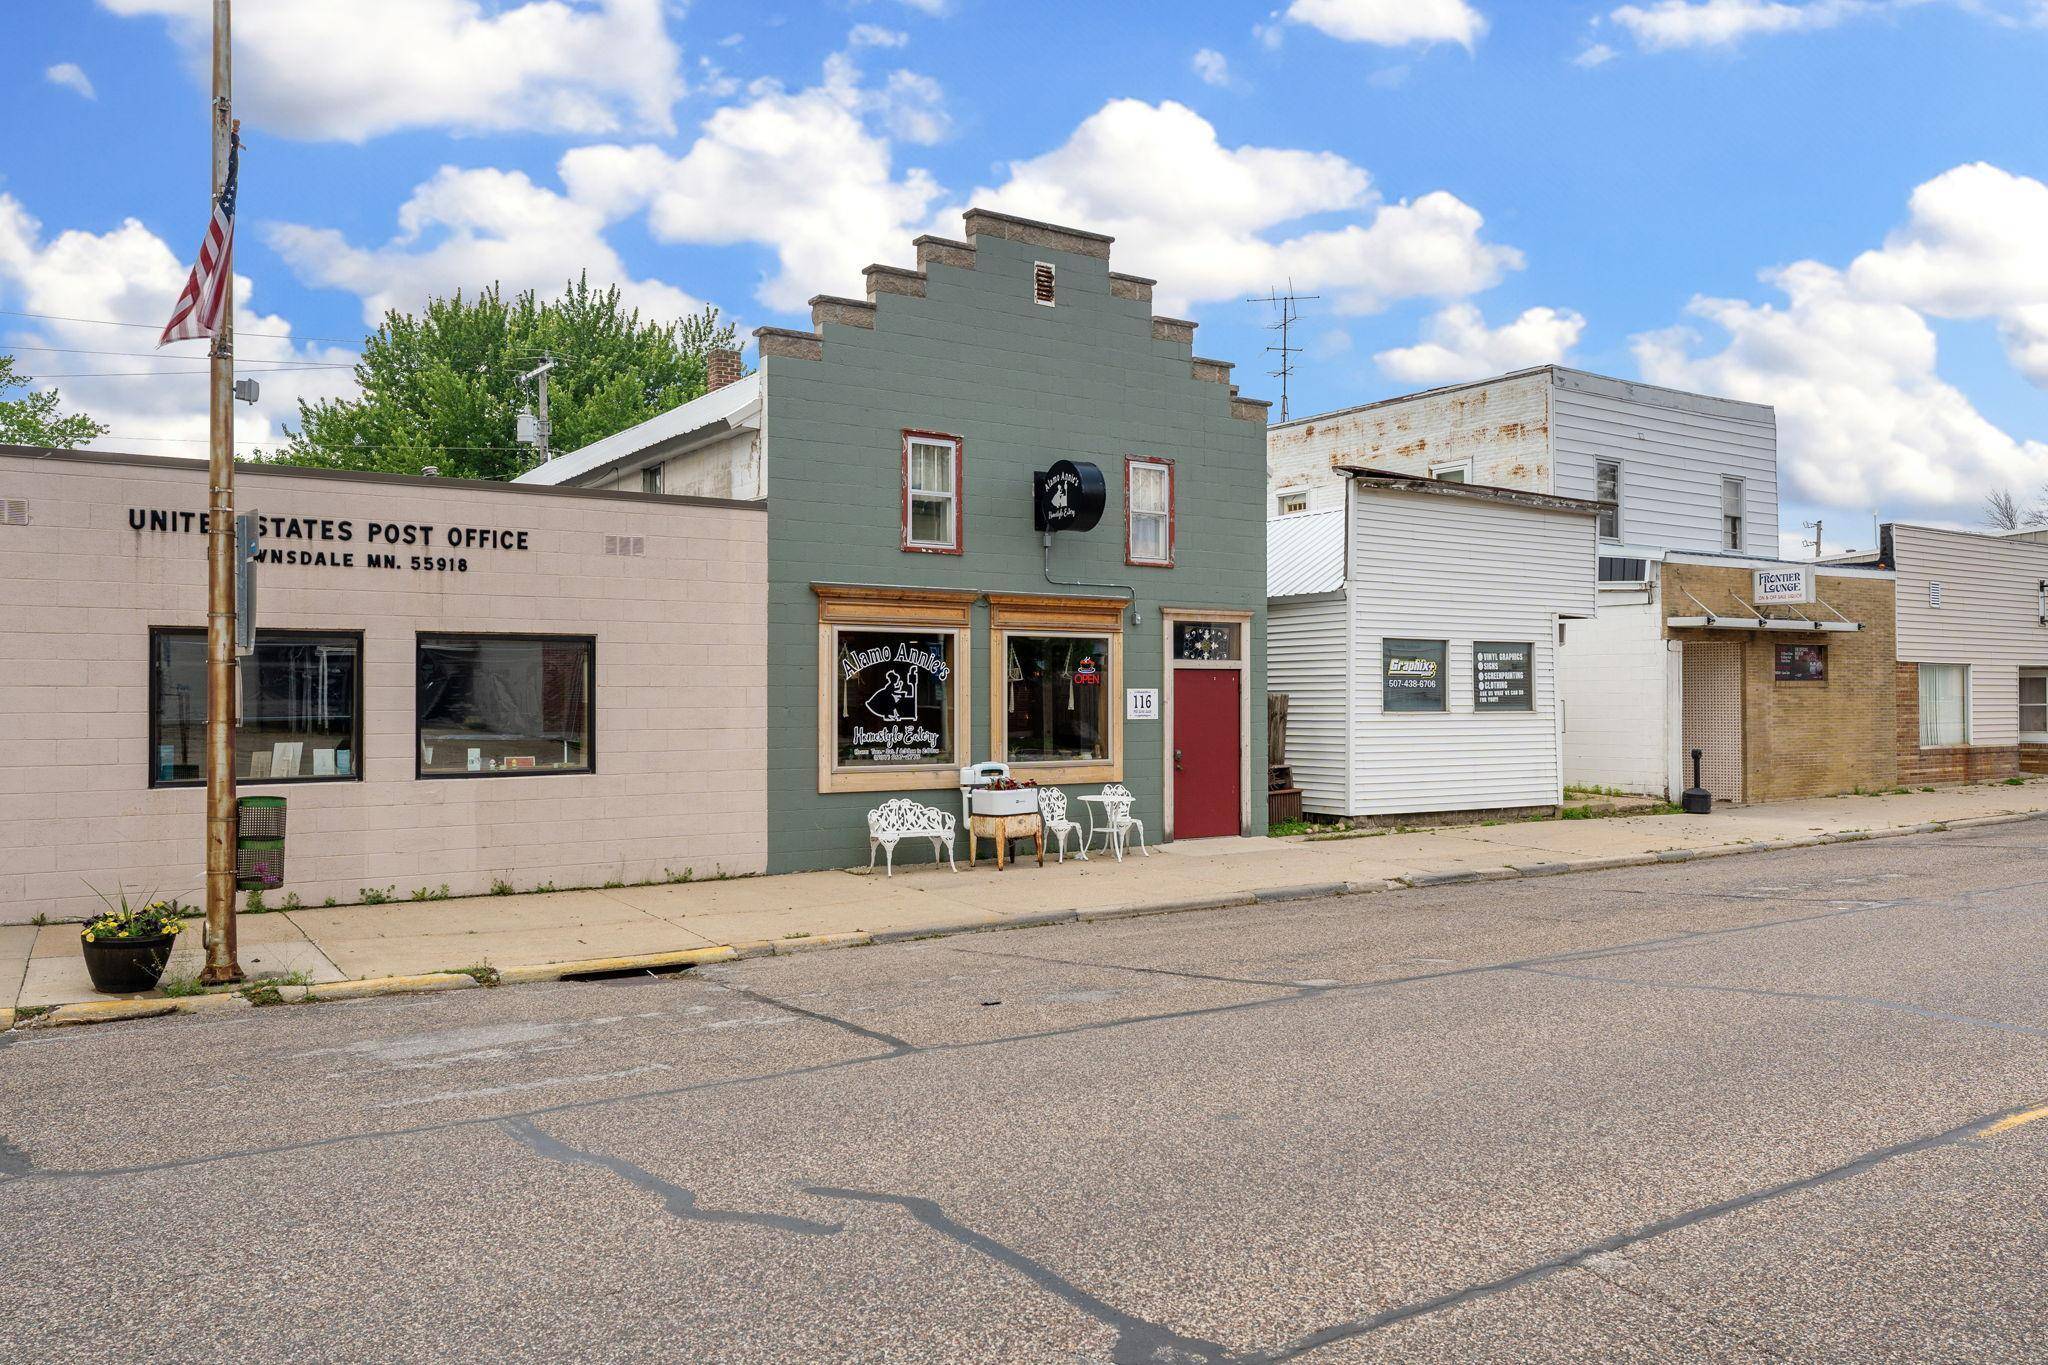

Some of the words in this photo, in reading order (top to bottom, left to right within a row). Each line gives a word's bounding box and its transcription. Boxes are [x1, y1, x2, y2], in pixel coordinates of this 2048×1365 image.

[129, 509, 209, 533] UNITE
[259, 516, 353, 541] STATES
[368, 523, 433, 547] POST
[448, 527, 528, 550] OFFICE
[367, 554, 401, 569] MN.
[411, 556, 467, 572] 55918
[1759, 573, 1800, 585] FRONTIER
[1764, 583, 1801, 593] LOUNGE
[842, 646, 891, 680] Alamo
[893, 642, 950, 681] Annie's
[1484, 653, 1498, 661] VINYL
[1074, 673, 1100, 684] OPEN
[1134, 695, 1151, 708] 116
[853, 725, 903, 748] Homestyle
[903, 725, 939, 748] Eatery
